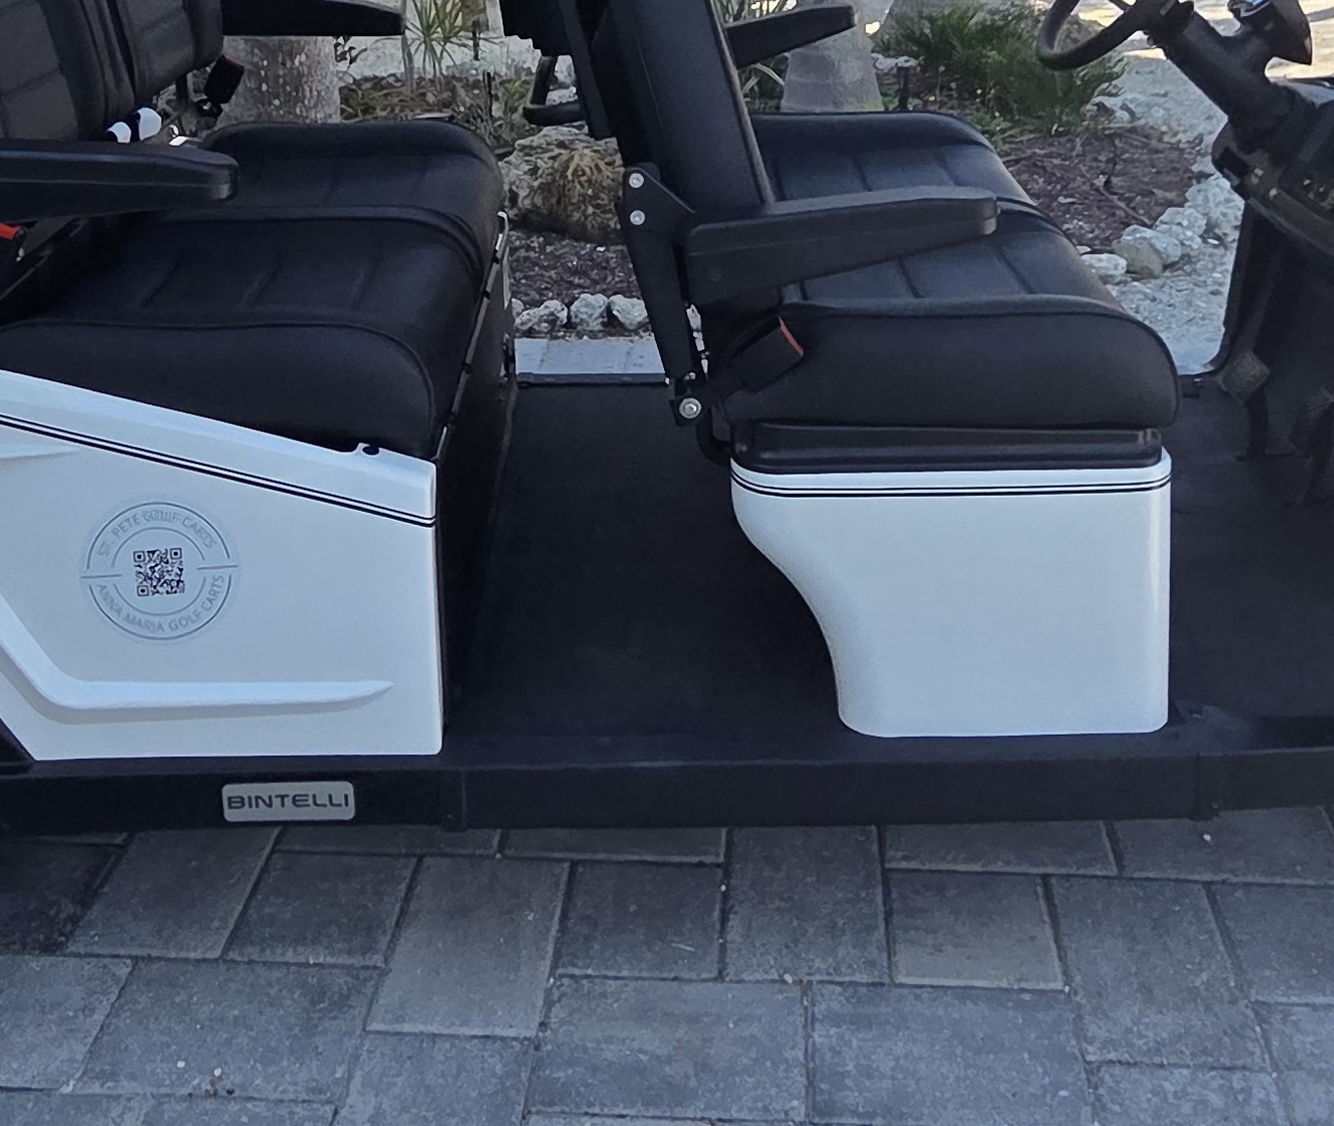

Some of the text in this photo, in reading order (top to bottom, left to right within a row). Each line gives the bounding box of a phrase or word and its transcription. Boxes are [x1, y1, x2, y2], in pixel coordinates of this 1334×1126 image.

[111, 513, 141, 539] PETE
[181, 517, 218, 549] CARTS
[97, 574, 224, 633] ANNA MARIA GOLF CARTS
[227, 793, 349, 810] BINTELLI
